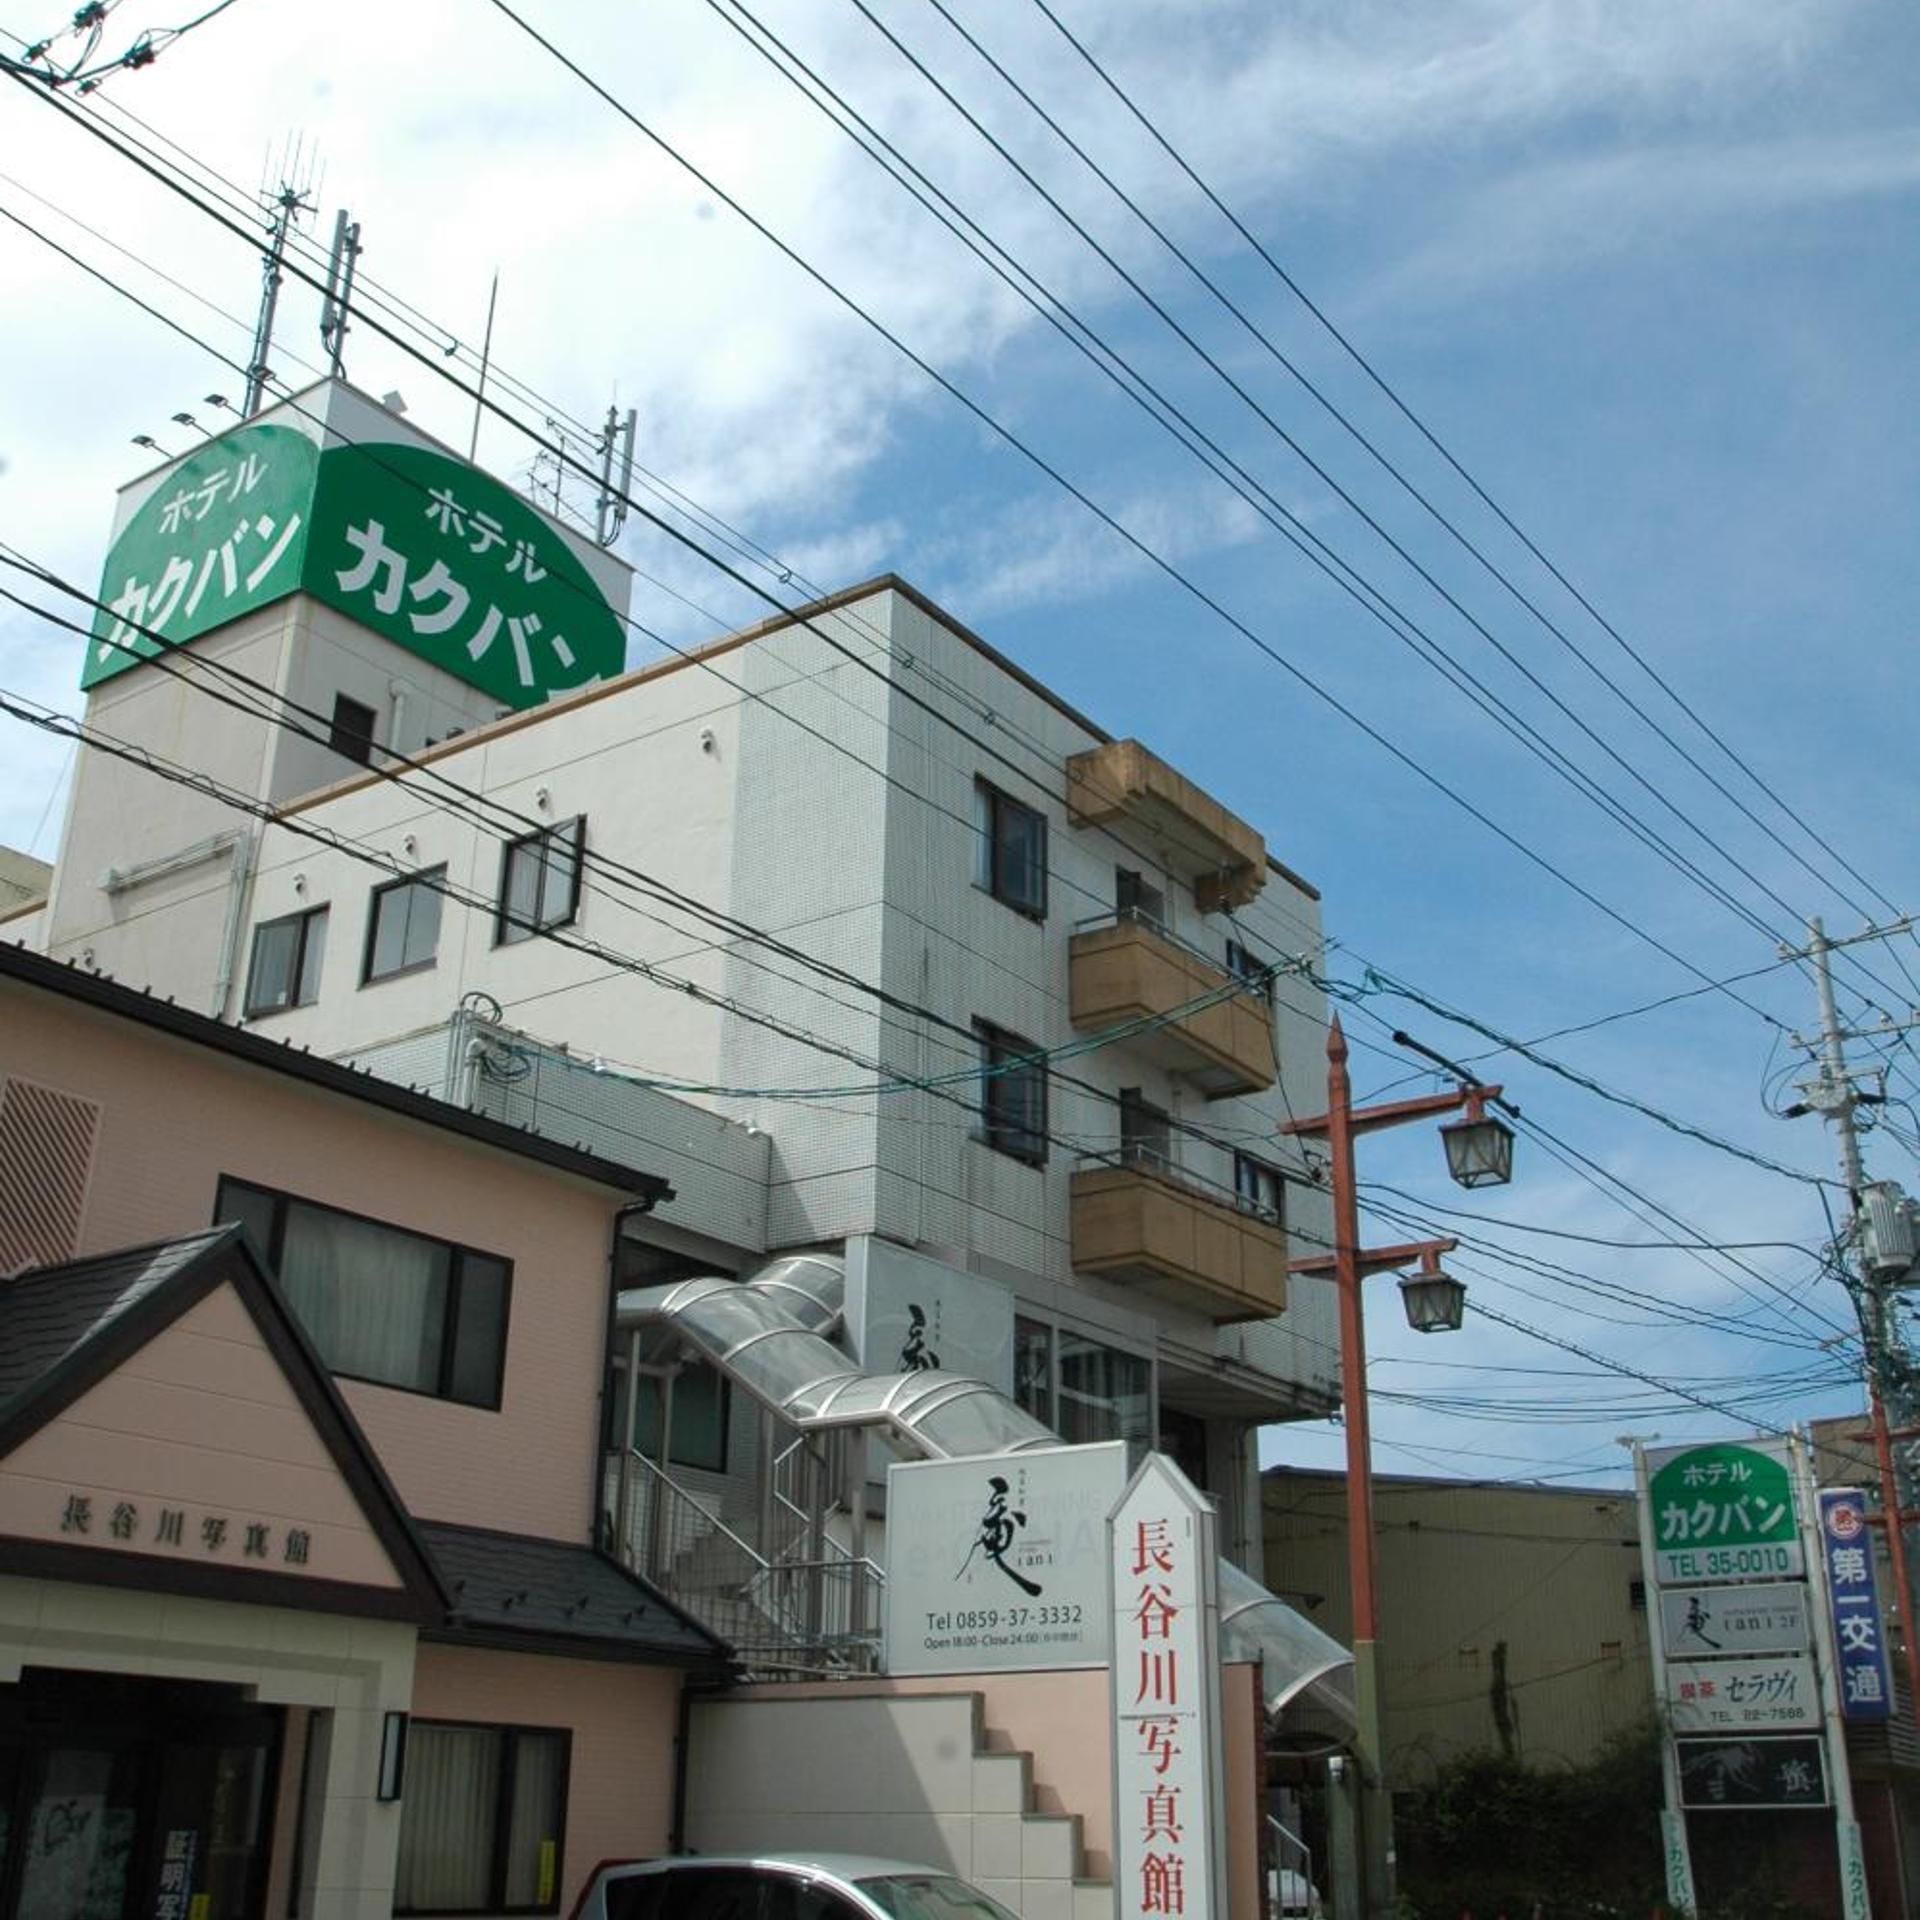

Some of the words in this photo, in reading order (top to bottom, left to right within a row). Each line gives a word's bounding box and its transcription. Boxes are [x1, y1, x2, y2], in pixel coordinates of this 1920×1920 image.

[159, 453, 268, 533] ホテル
[424, 488, 548, 583] ホテル
[98, 513, 301, 665] カクバン
[1682, 1461, 1752, 1487] ホテル
[60, 1494, 311, 1565] 長谷川写真館
[1662, 1494, 1786, 1541] カクバン
[1668, 1554, 1702, 1580] TEL
[1706, 1548, 1788, 1576] 35-0010
[926, 1612, 950, 1630] Tel
[956, 1605, 1082, 1629] 0859-37-3332
[1832, 1547, 1884, 1703] 第一交通
[924, 1637, 950, 1649] Open
[1725, 1670, 1798, 1702] セラヴィ
[1131, 1518, 1184, 1916] 長谷川写真館
[1710, 1711, 1733, 1722] TEL
